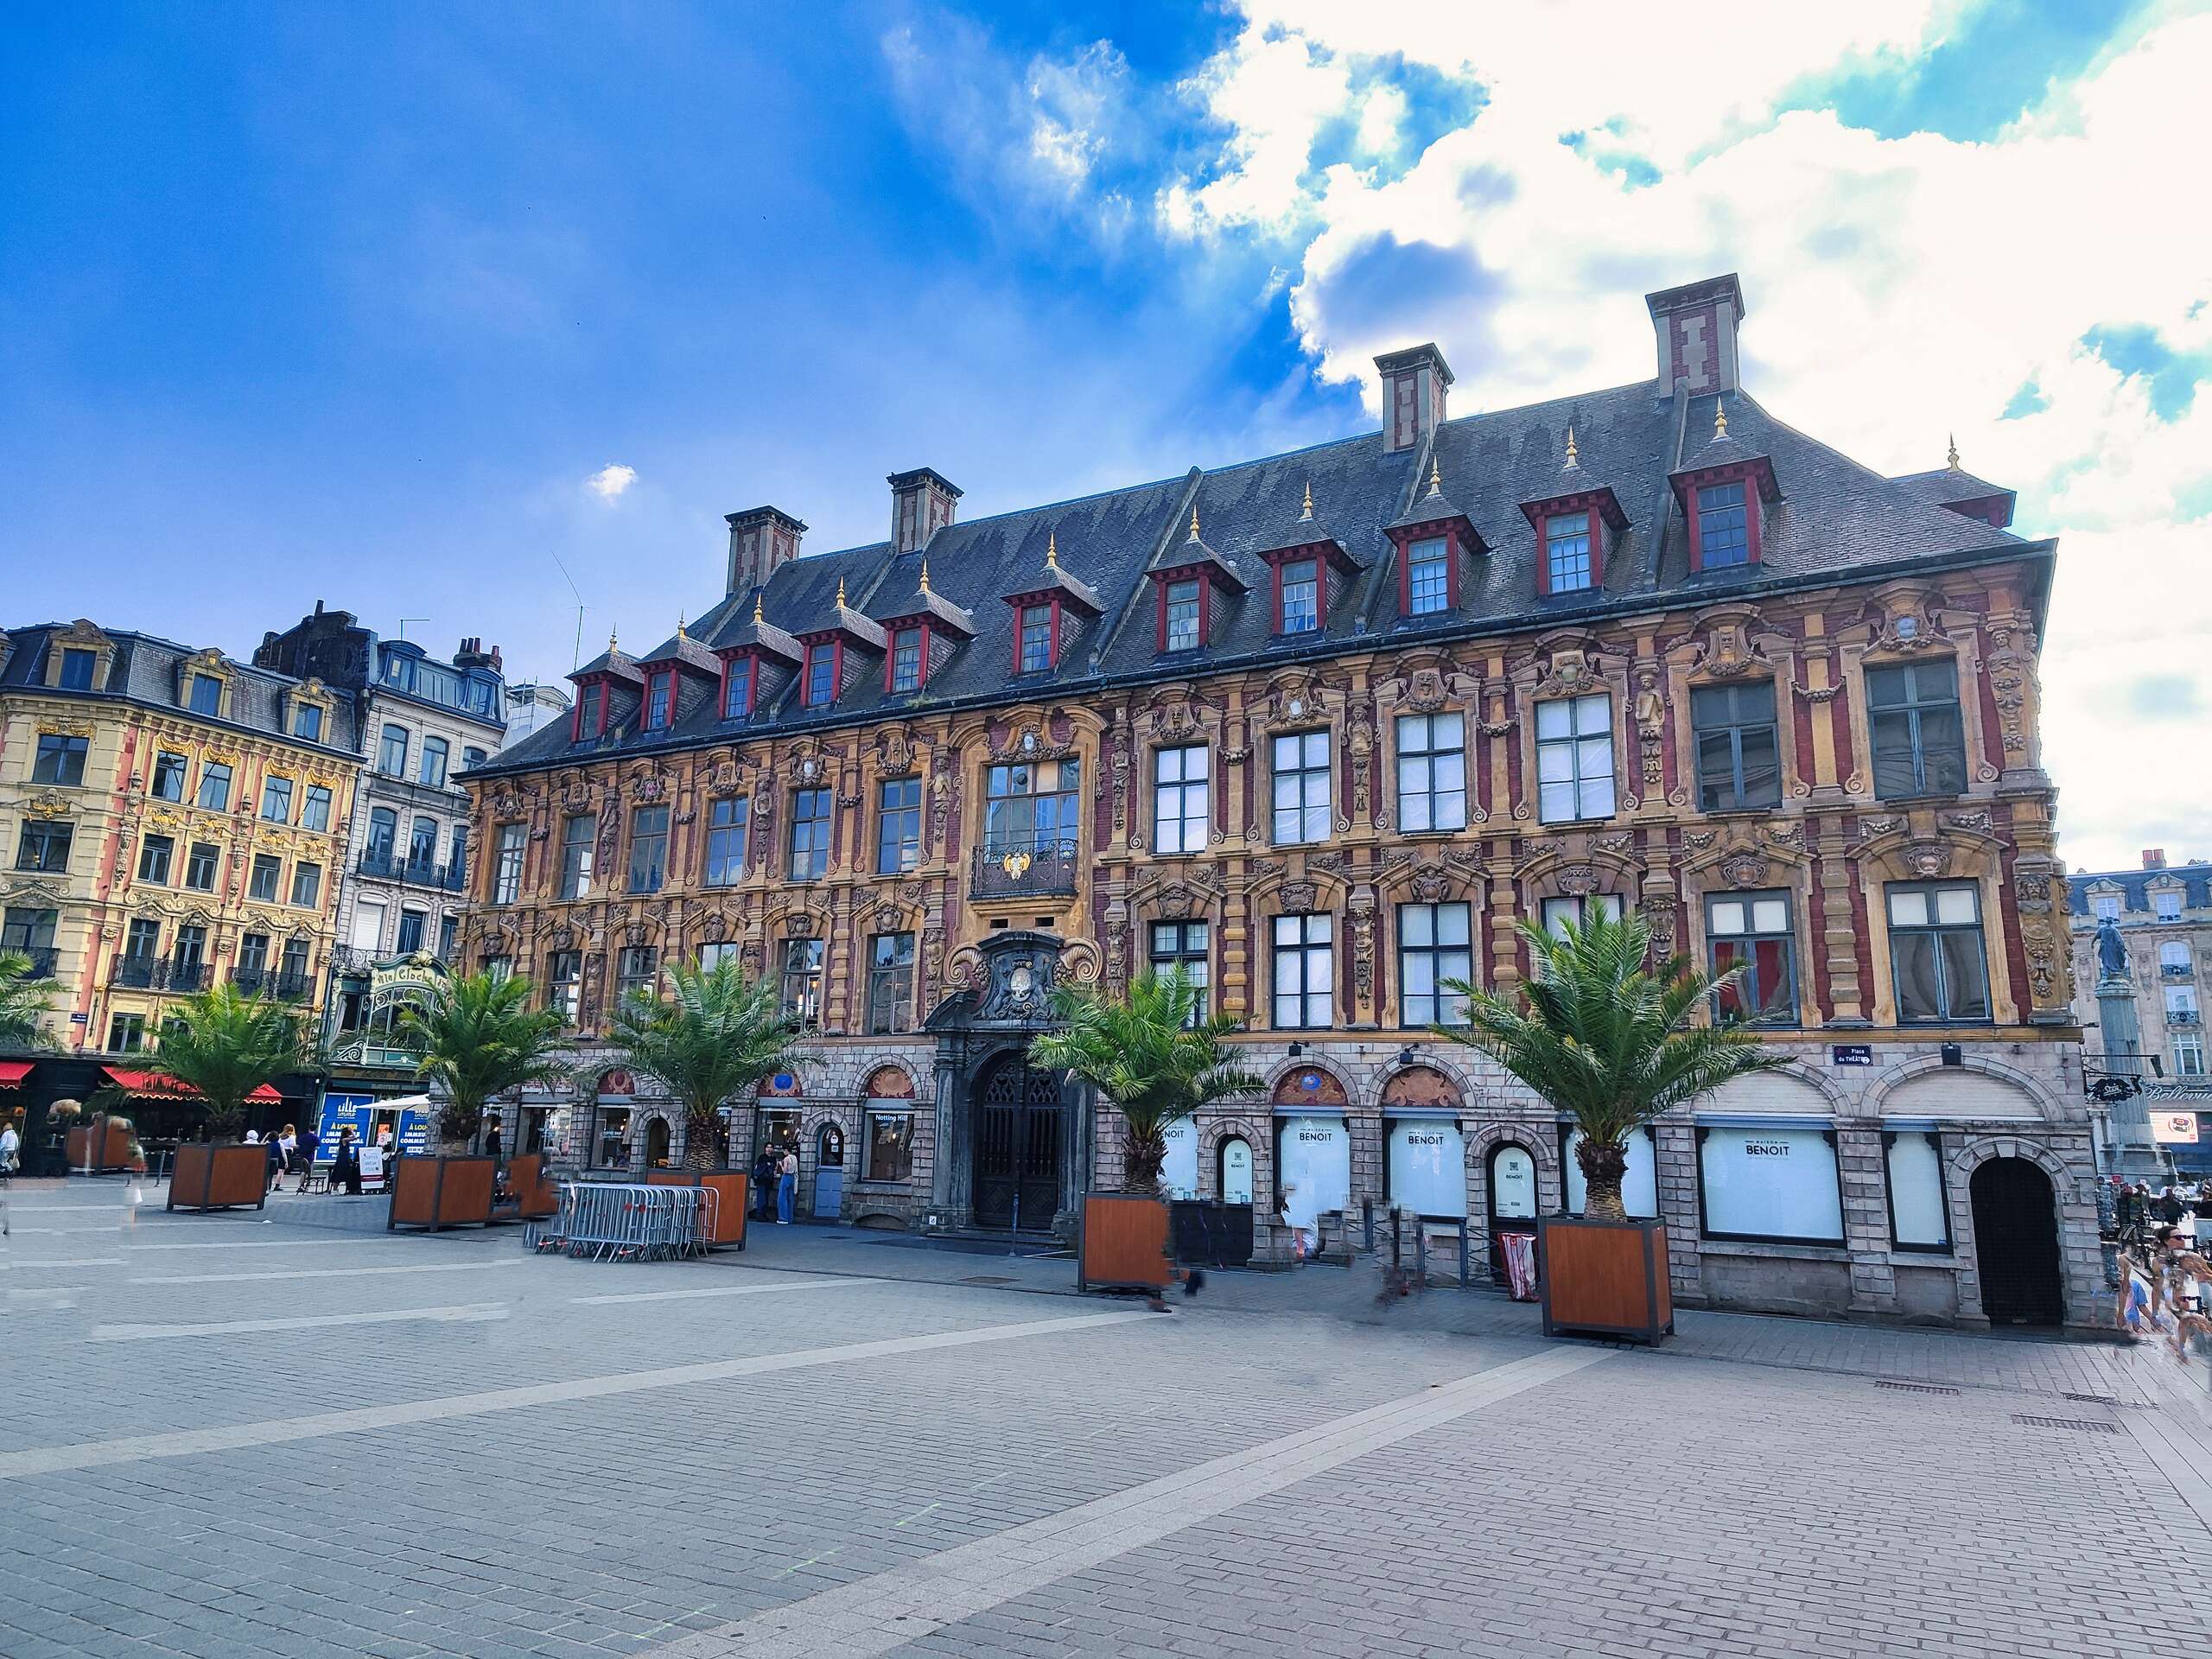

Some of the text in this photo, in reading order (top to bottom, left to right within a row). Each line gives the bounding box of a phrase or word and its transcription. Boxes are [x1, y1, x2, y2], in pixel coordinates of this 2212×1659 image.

[1299, 1132, 1332, 1141] BENOIT
[1408, 1135, 1444, 1145] BENOIT
[1746, 1145, 1789, 1155] BENOIT
